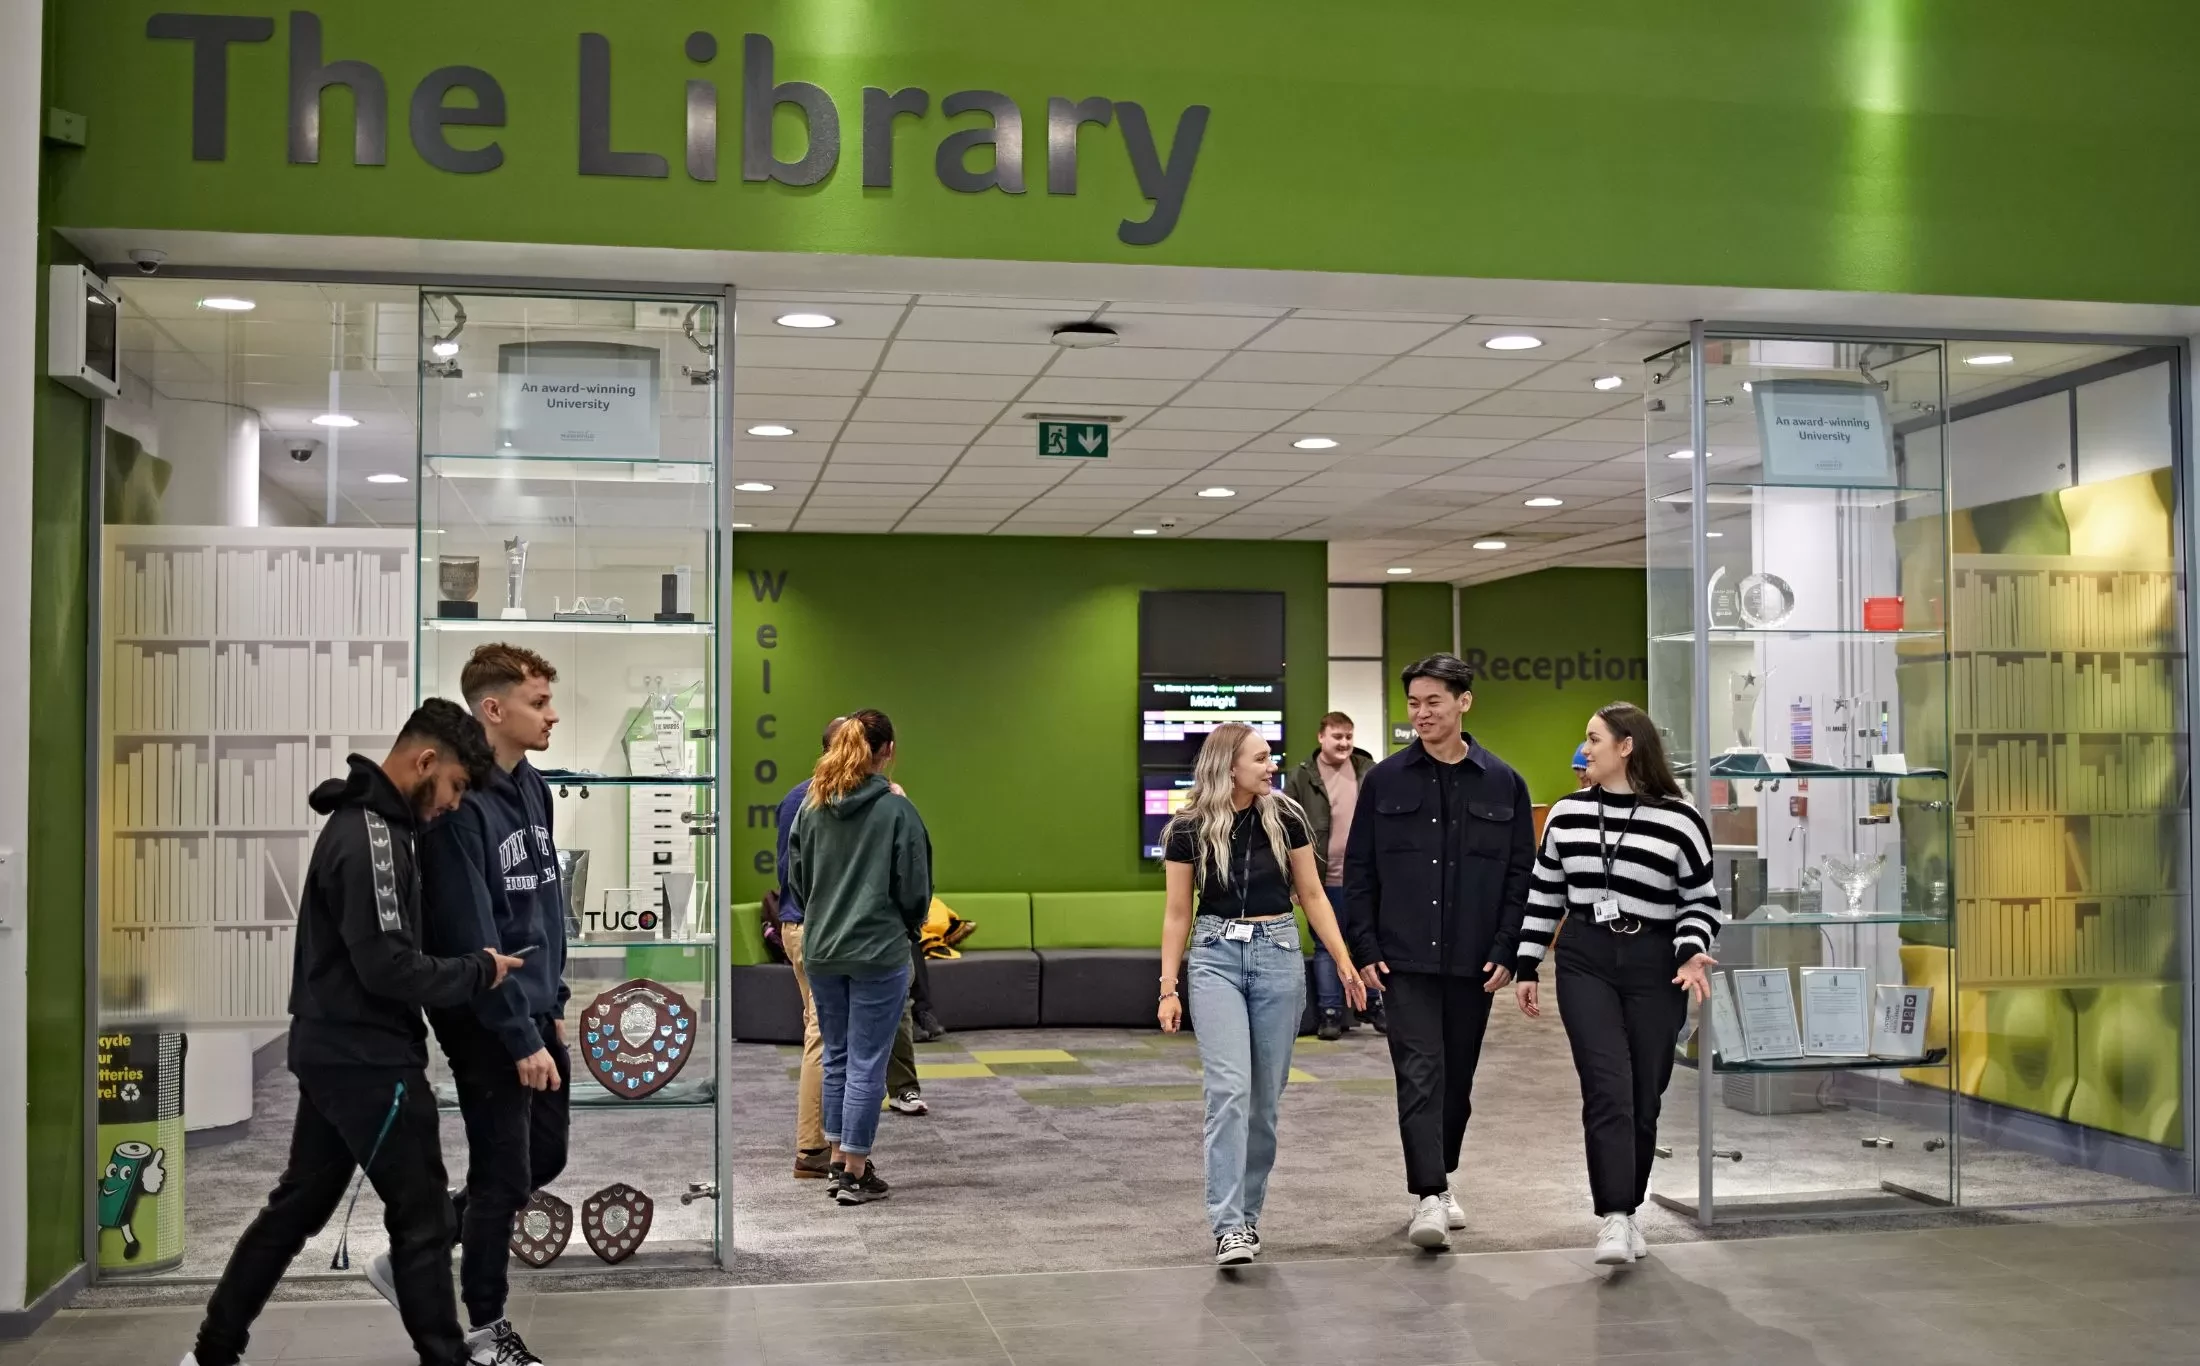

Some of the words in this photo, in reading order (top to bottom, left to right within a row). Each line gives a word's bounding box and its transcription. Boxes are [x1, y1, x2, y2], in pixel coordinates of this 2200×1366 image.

[147, 11, 507, 174] The
[579, 31, 1211, 246] Library
[521, 382, 538, 393] An
[541, 383, 636, 397] award-winning
[547, 398, 610, 412] University
[1776, 416, 1790, 425] An
[1793, 417, 1870, 430] award-winning
[1799, 431, 1851, 444] University
[1466, 648, 1648, 690] Reception
[1190, 695, 1236, 709] Midnight
[748, 569, 788, 875] Welcome
[1395, 728, 1411, 739] Day
[585, 911, 657, 930] TUCO
[99, 1034, 131, 1049] cycle
[98, 1054, 112, 1064] ur
[98, 1066, 144, 1081] tteries
[98, 1084, 117, 1098] re!
